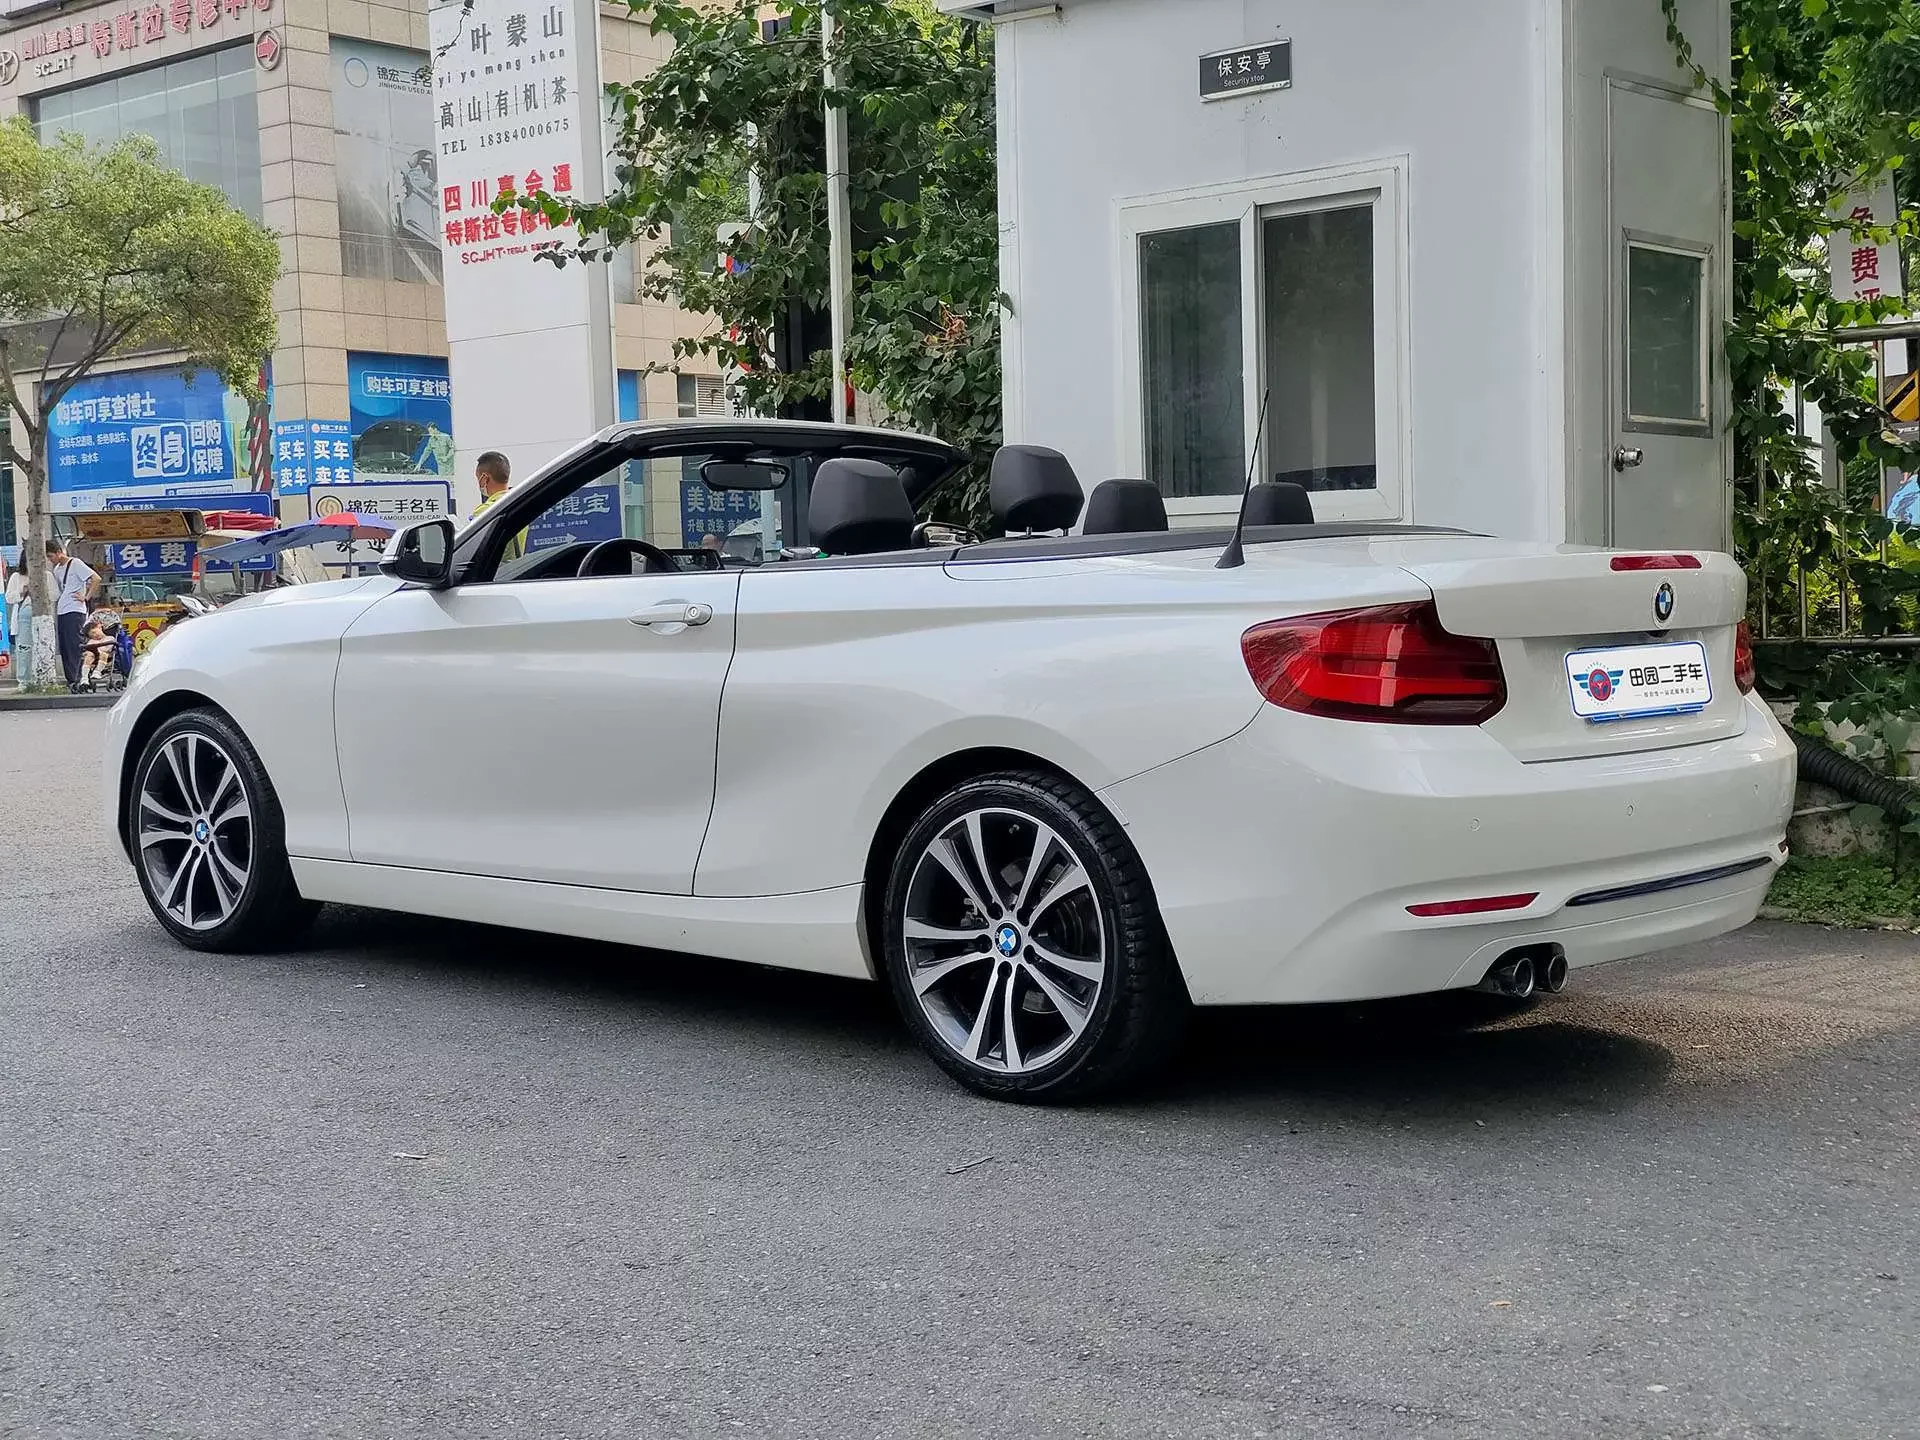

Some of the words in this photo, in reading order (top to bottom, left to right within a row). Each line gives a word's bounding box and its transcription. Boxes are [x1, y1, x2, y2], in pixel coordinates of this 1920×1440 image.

[471, 5, 564, 55] 叶蒙山
[1218, 50, 1271, 77] 保安亭
[1223, 77, 1250, 87] Security
[1251, 74, 1265, 83] stop
[442, 139, 467, 155] TEL
[480, 118, 569, 147] 18384000675
[445, 209, 573, 247] 特斯拉专修中
[367, 376, 452, 397] 购车可享查博
[56, 391, 156, 426] 购车可享查博士
[191, 419, 222, 447] 回购
[135, 431, 185, 470] 终身
[192, 447, 224, 475] 保障
[279, 440, 306, 462] 买车
[313, 440, 350, 460] 买车
[280, 466, 308, 489] 卖车
[315, 466, 352, 484] 卖车
[347, 498, 440, 515] 锦宏二手名车
[1629, 663, 1703, 687] 田园二手车
